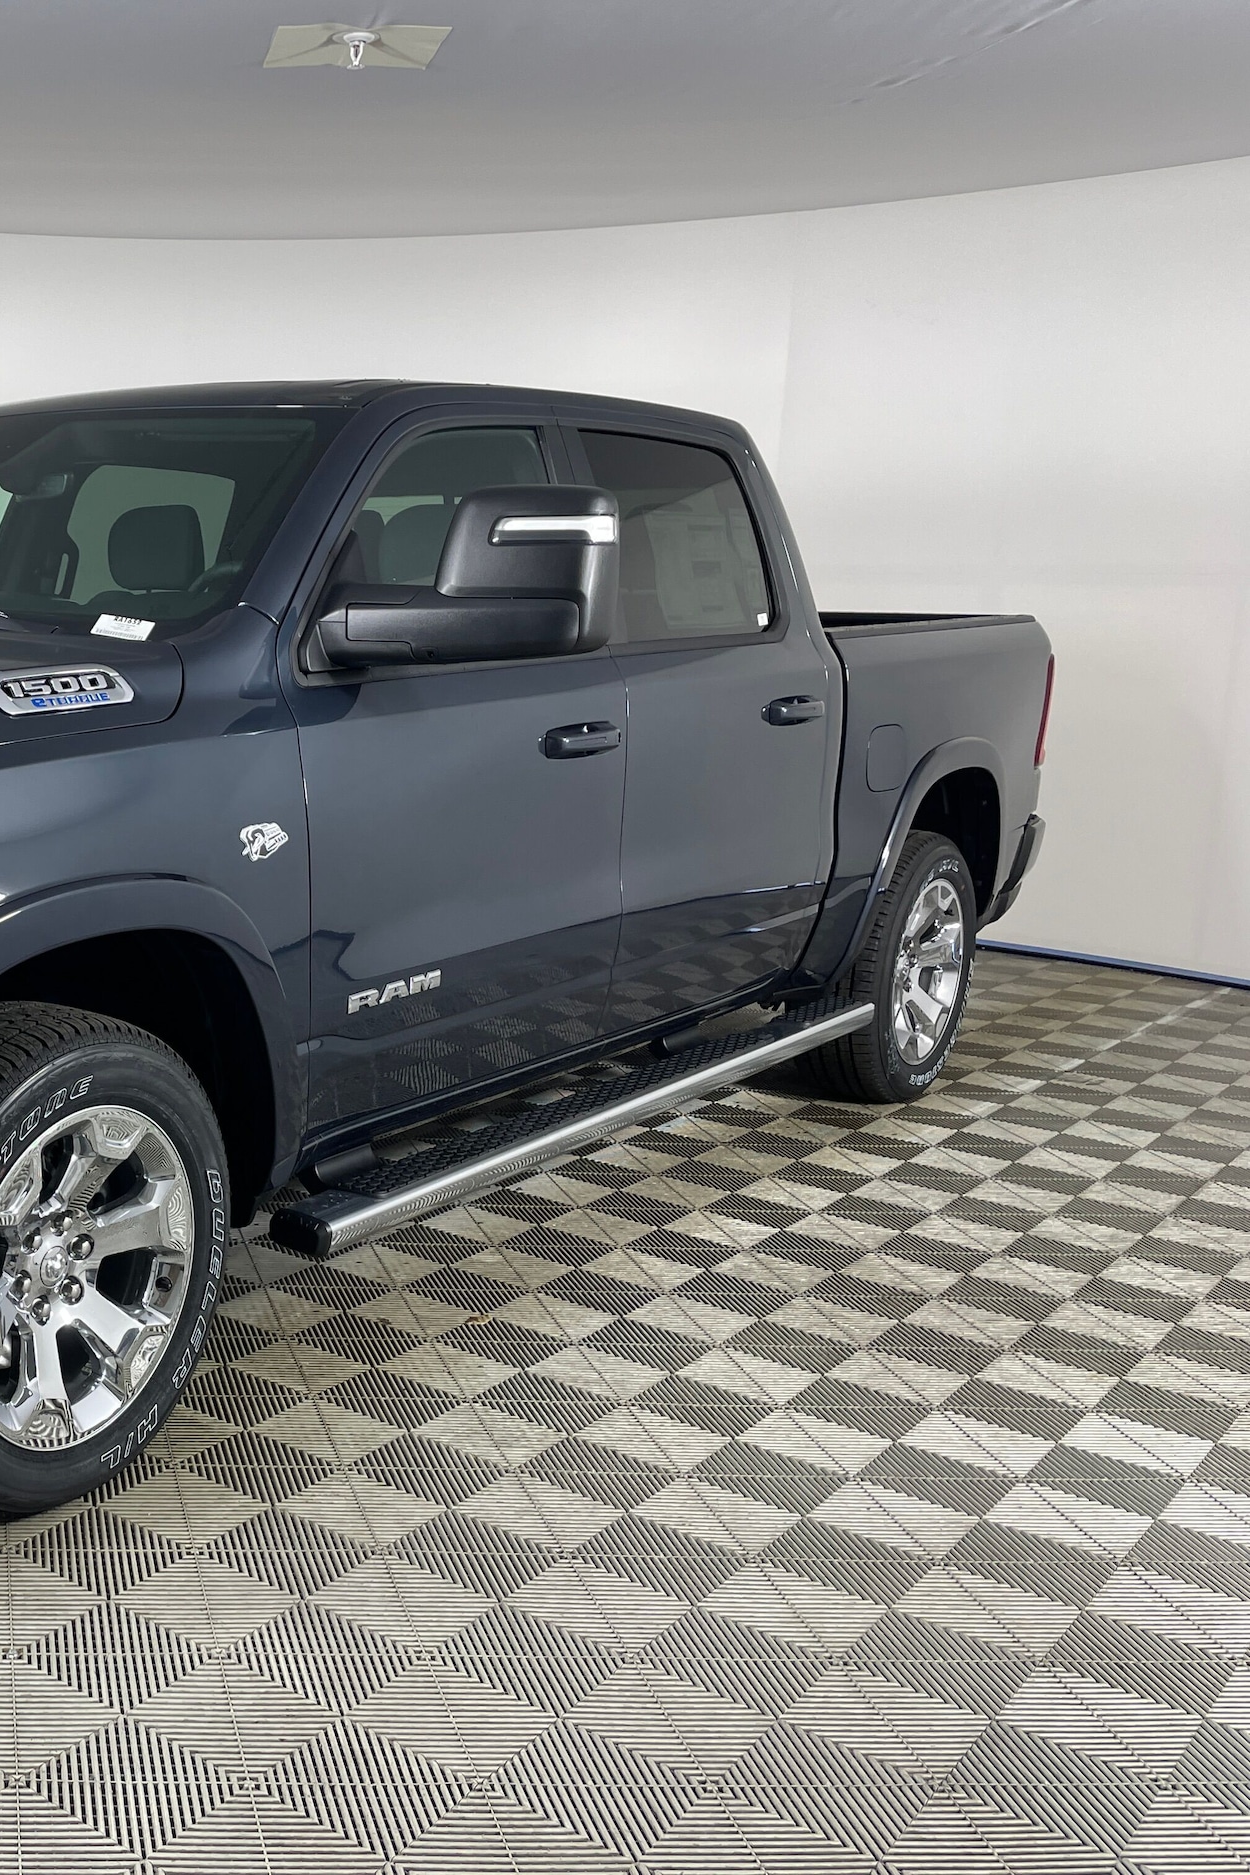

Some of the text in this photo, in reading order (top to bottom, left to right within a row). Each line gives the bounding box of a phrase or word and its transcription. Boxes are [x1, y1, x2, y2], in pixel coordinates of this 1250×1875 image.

[6, 673, 109, 698] 1500
[346, 968, 442, 1015] RAM
[100, 1168, 227, 1471] DUELER H/L
